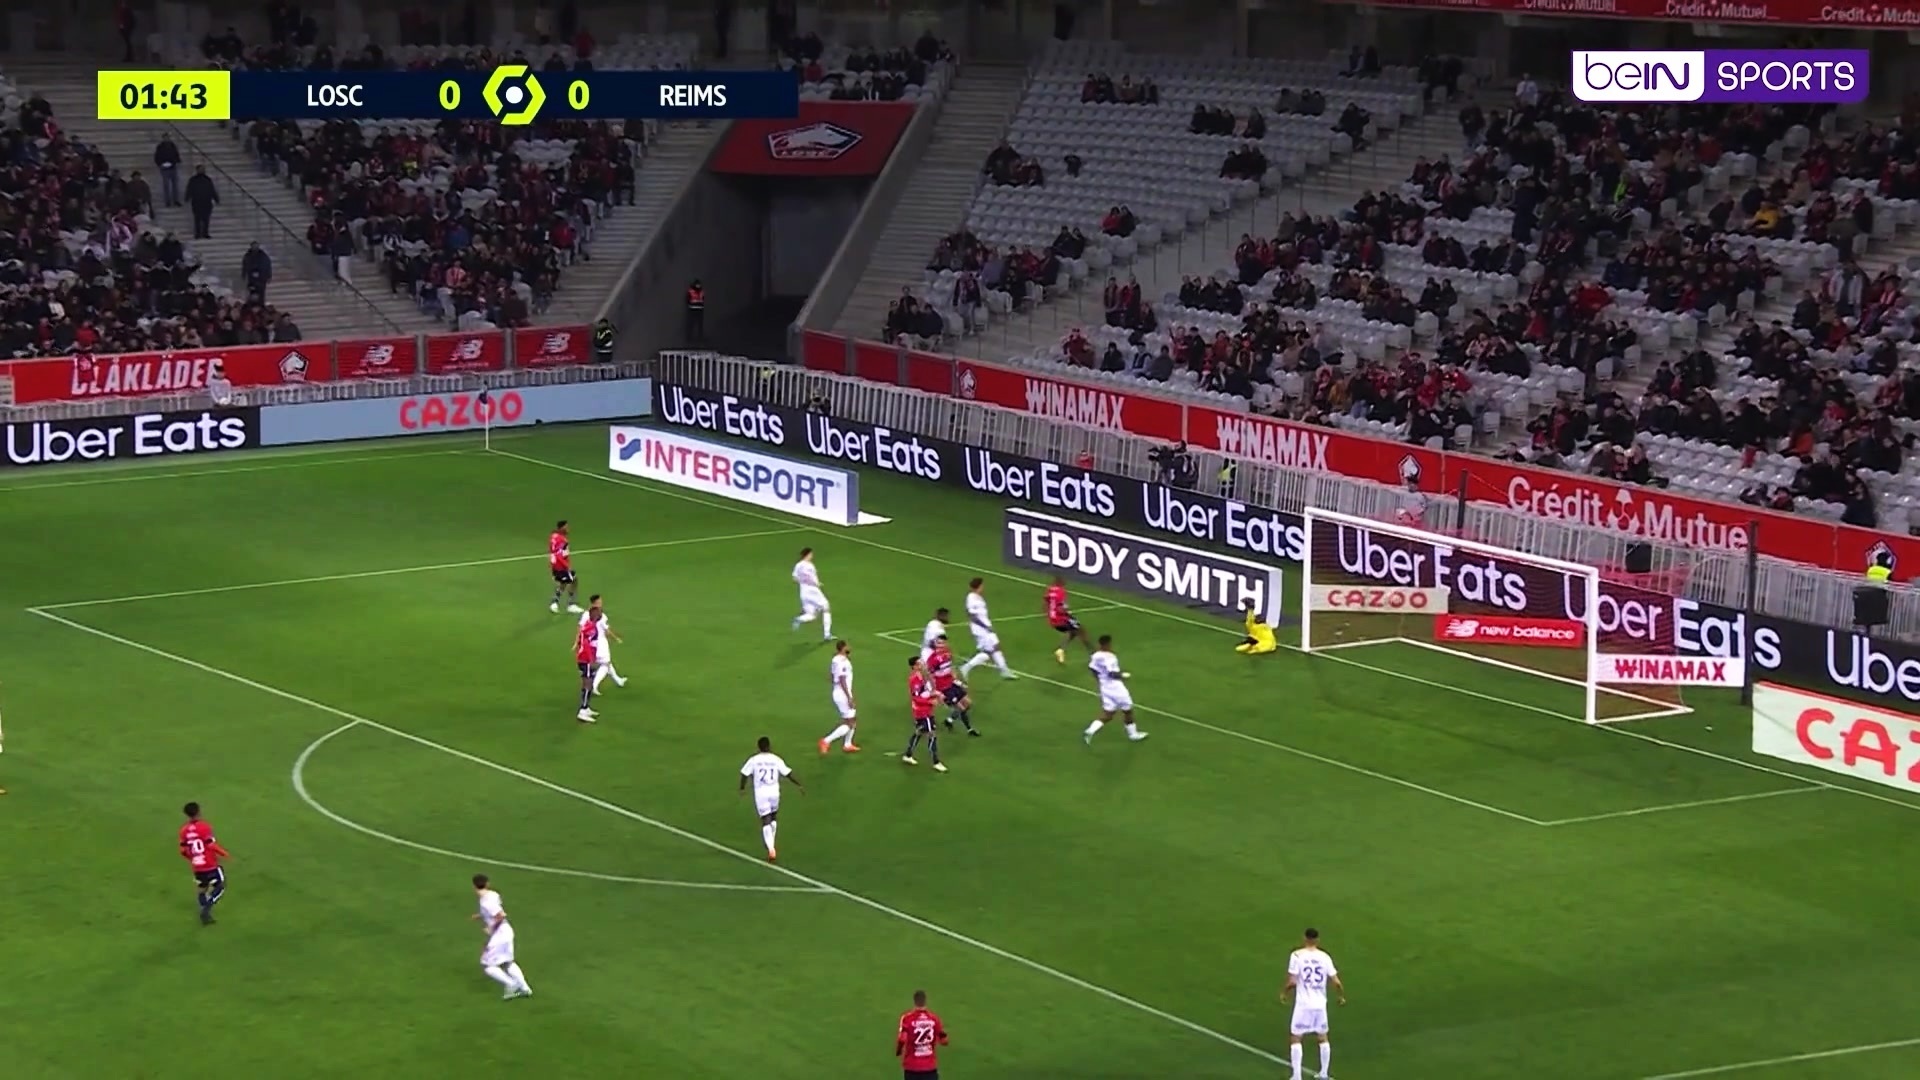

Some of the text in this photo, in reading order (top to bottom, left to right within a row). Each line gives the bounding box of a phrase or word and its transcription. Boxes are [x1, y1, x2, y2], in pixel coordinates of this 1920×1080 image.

[1720, 4, 1767, 19] Mutuel
[400, 390, 523, 429] CAZOO
[660, 384, 785, 446] Uber Eats
[1025, 379, 1126, 432] WINAMAX
[7, 412, 247, 464] Uber Eats
[806, 413, 941, 480] Uber Eats
[1217, 416, 1330, 472] WINAMAX
[965, 447, 1115, 517] Uber Eats
[1143, 483, 1305, 561] Uber Eats
[1508, 475, 1749, 551] Crédit Mutue
[1008, 522, 1264, 616] TEDDY SMITH
[1338, 525, 1527, 611] Uber Eats
[1327, 589, 1428, 608] CAZOO
[1563, 572, 1782, 669] Uber Eats
[1480, 626, 1511, 636] new
[1513, 625, 1576, 639] balance
[1614, 658, 1727, 683] WINAMAX
[758, 768, 775, 782] 21
[1303, 966, 1324, 984] 25
[914, 1027, 934, 1045] 23
